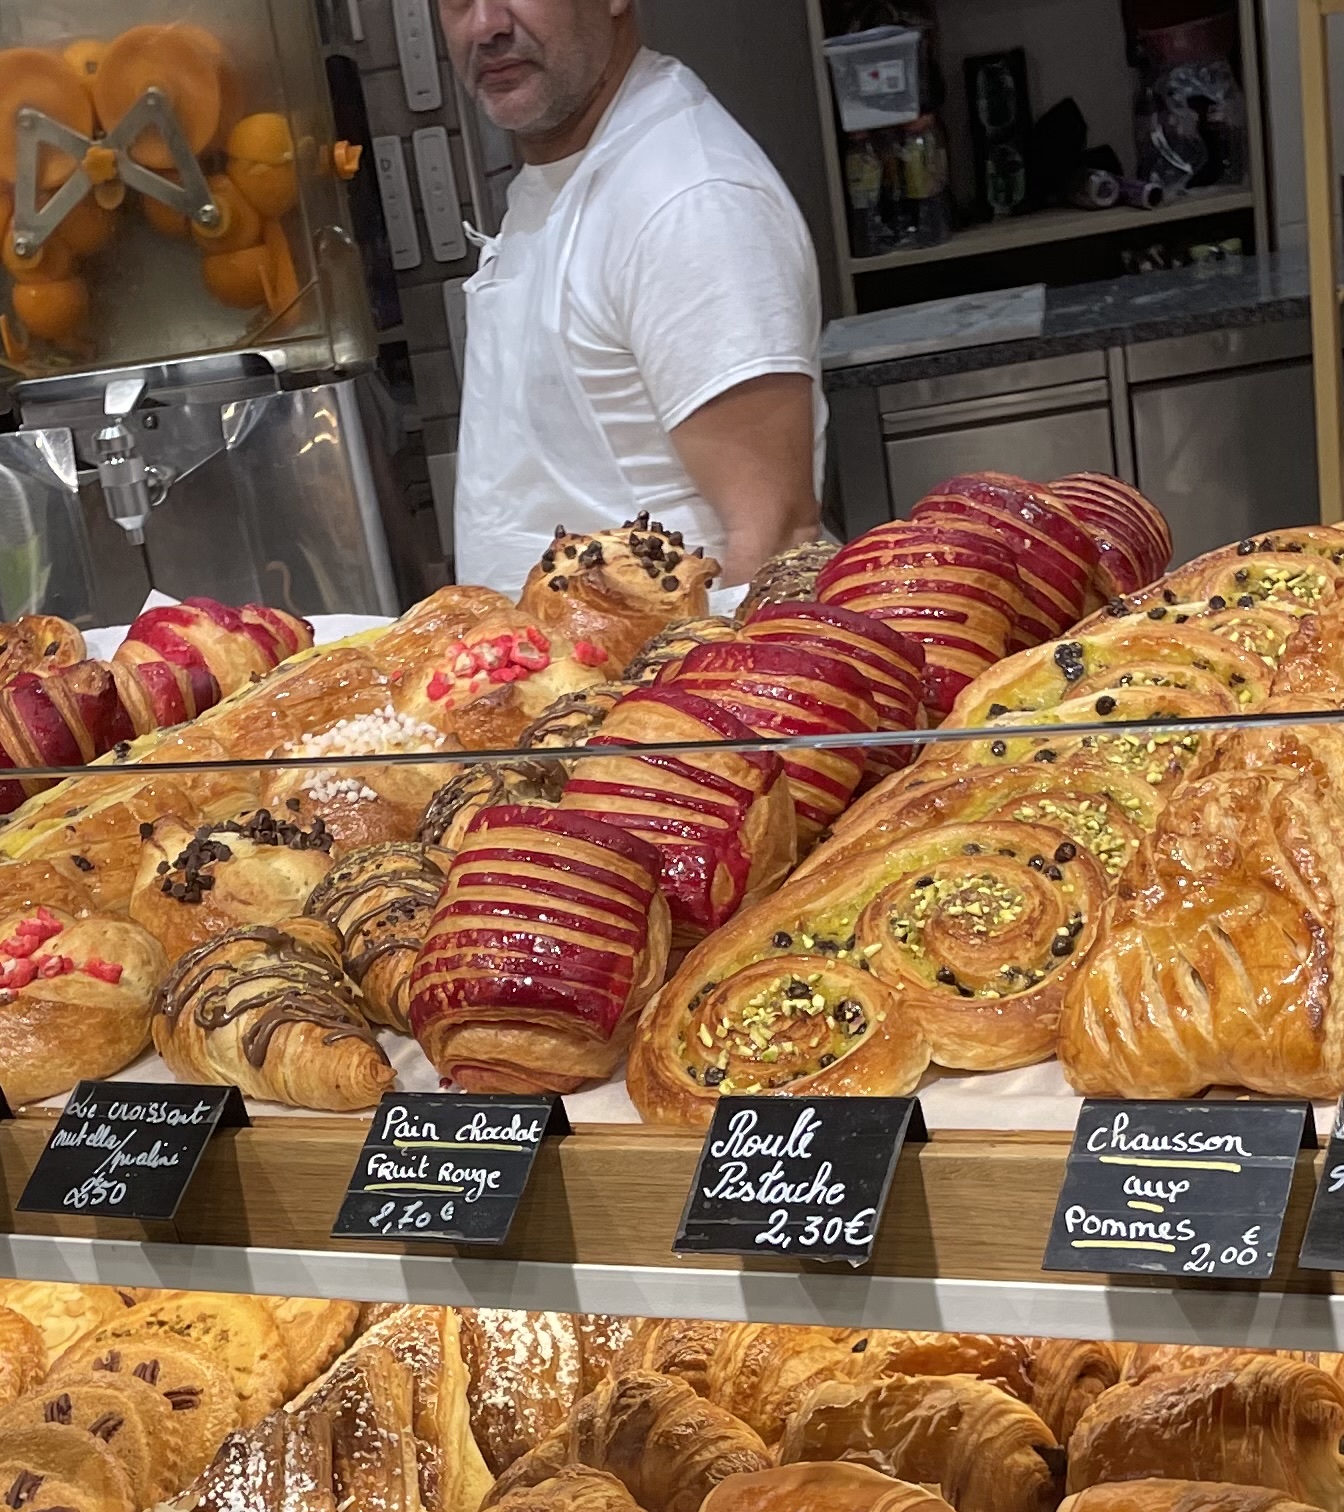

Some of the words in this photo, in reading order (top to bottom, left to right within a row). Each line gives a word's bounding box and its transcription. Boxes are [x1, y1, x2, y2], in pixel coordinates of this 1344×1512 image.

[65, 1086, 99, 1119] Le
[380, 1105, 440, 1141] Pain
[454, 1111, 544, 1144] chocolat
[710, 1106, 823, 1159] Roulé
[437, 1161, 502, 1204] Rouge
[702, 1159, 846, 1206] Pistache
[1122, 1175, 1191, 1204] aux
[754, 1207, 878, 1249] 2,30€
[1063, 1204, 1196, 1242] Pommes
